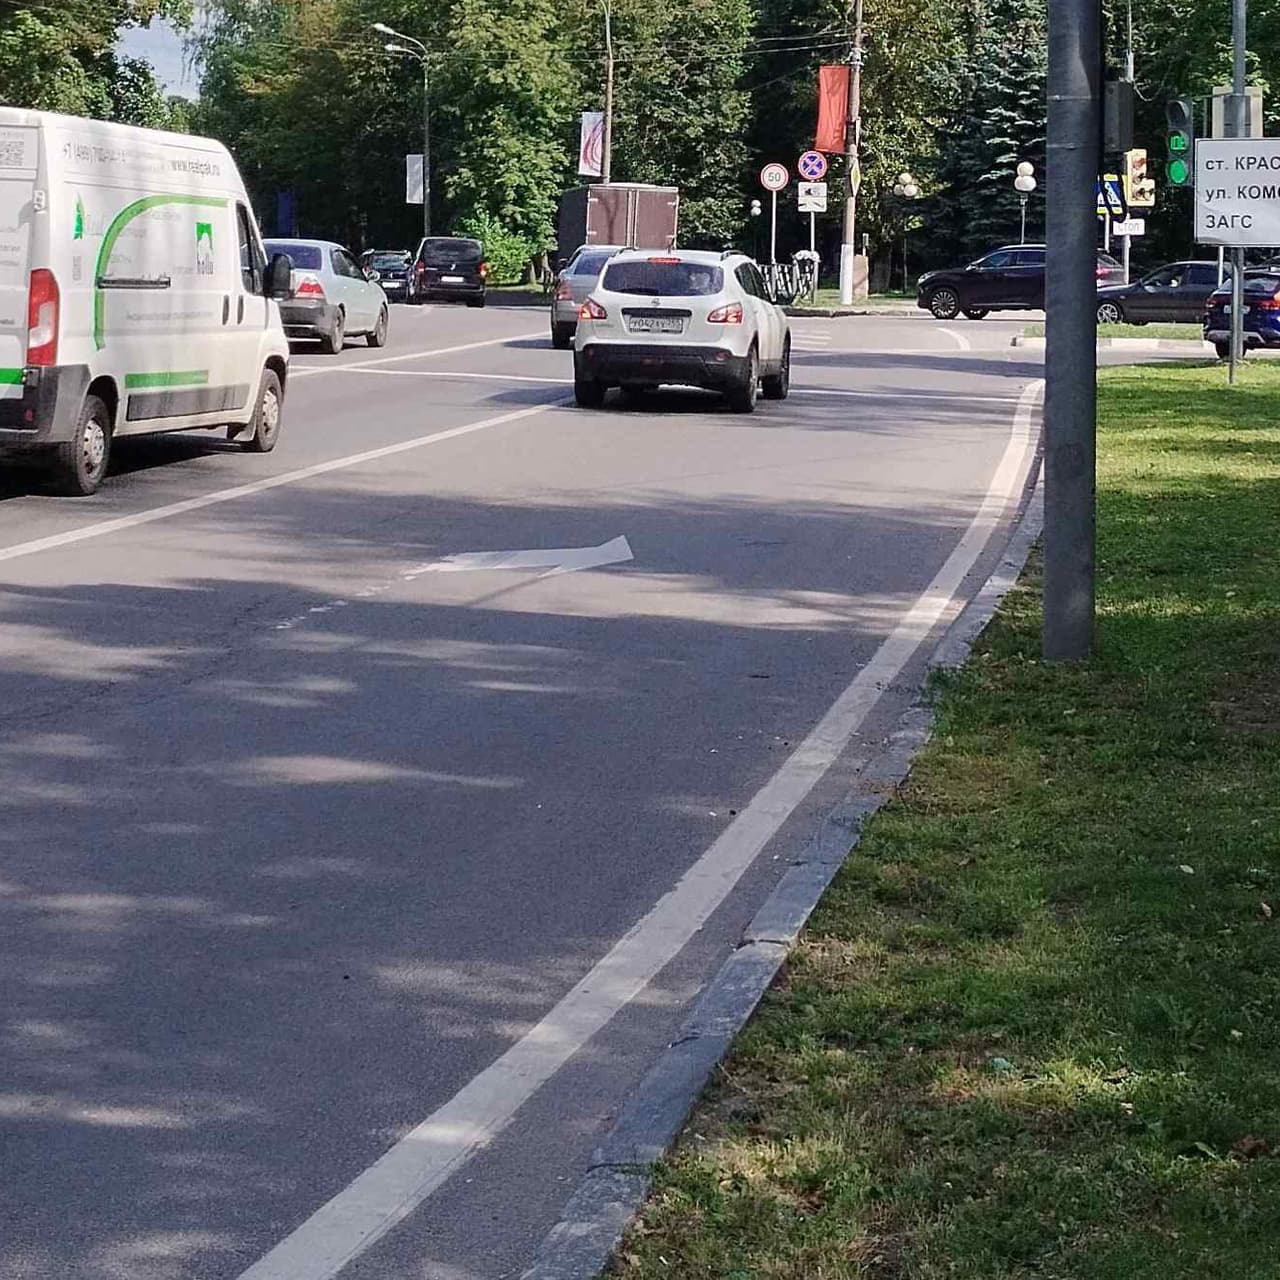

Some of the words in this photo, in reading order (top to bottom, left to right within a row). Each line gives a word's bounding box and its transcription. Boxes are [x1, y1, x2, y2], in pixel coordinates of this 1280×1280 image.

[1205, 158, 1229, 170] ст.
[768, 172, 781, 182] 50
[1205, 188, 1231, 203] ул.
[1205, 215, 1252, 229] ЗАГС
